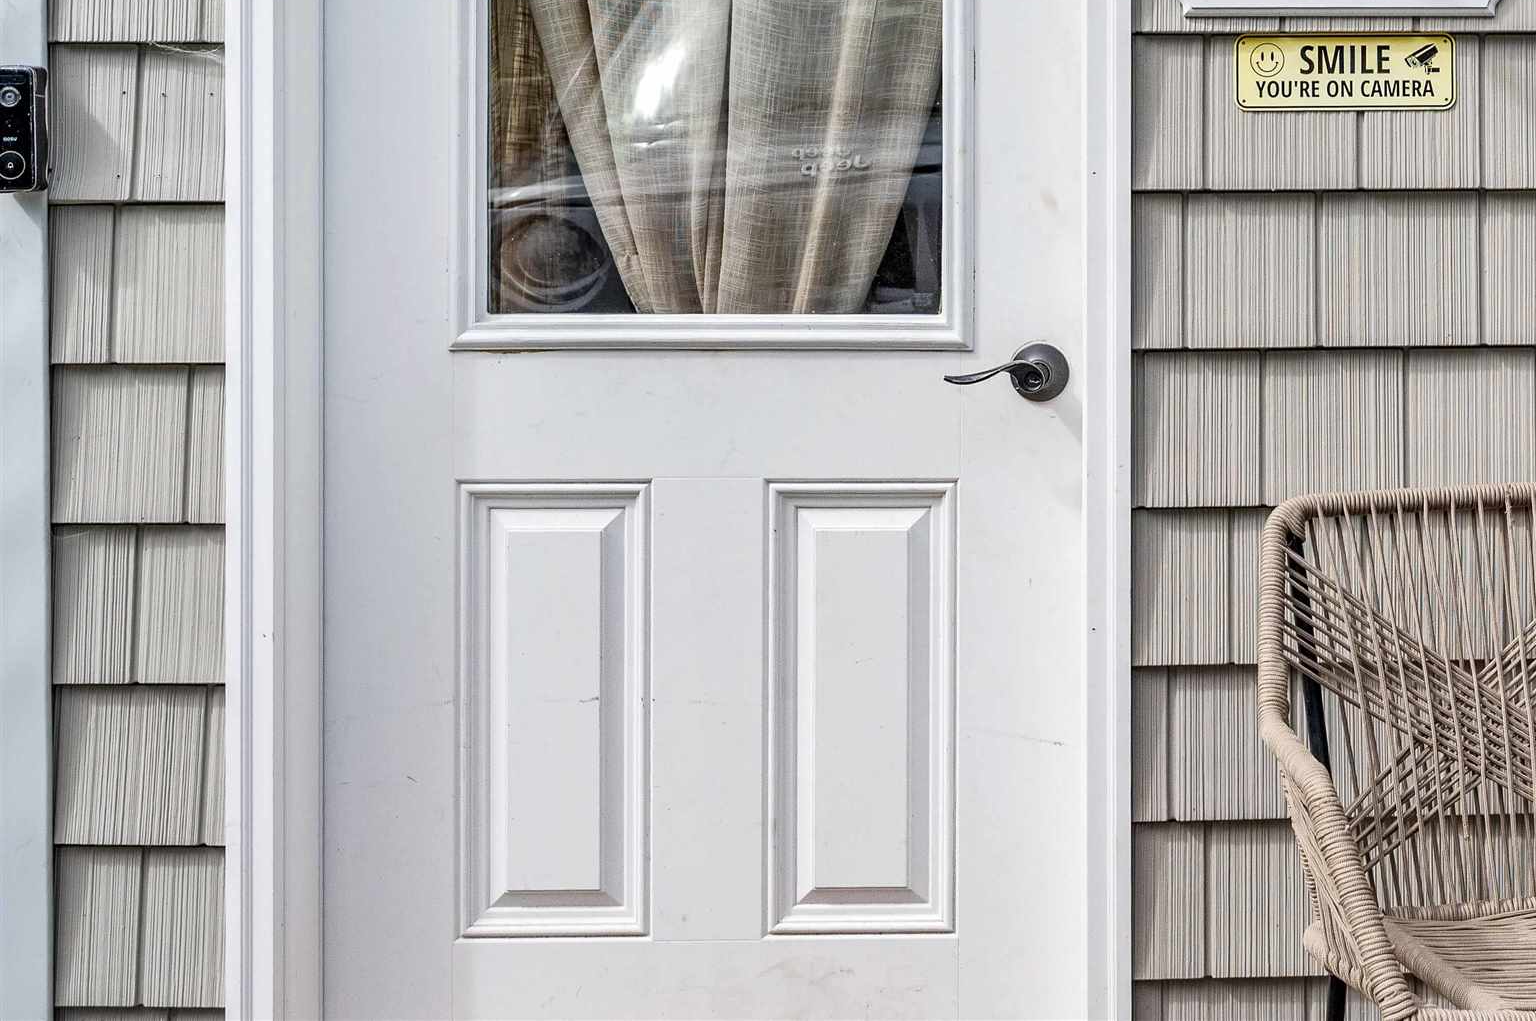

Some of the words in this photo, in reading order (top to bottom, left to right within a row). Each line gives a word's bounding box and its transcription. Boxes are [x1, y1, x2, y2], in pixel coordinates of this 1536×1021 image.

[1300, 45, 1390, 74] SMILE
[1256, 81, 1319, 97] YOU'RE
[1327, 81, 1352, 97] ON
[1361, 80, 1434, 97] CAMERA
